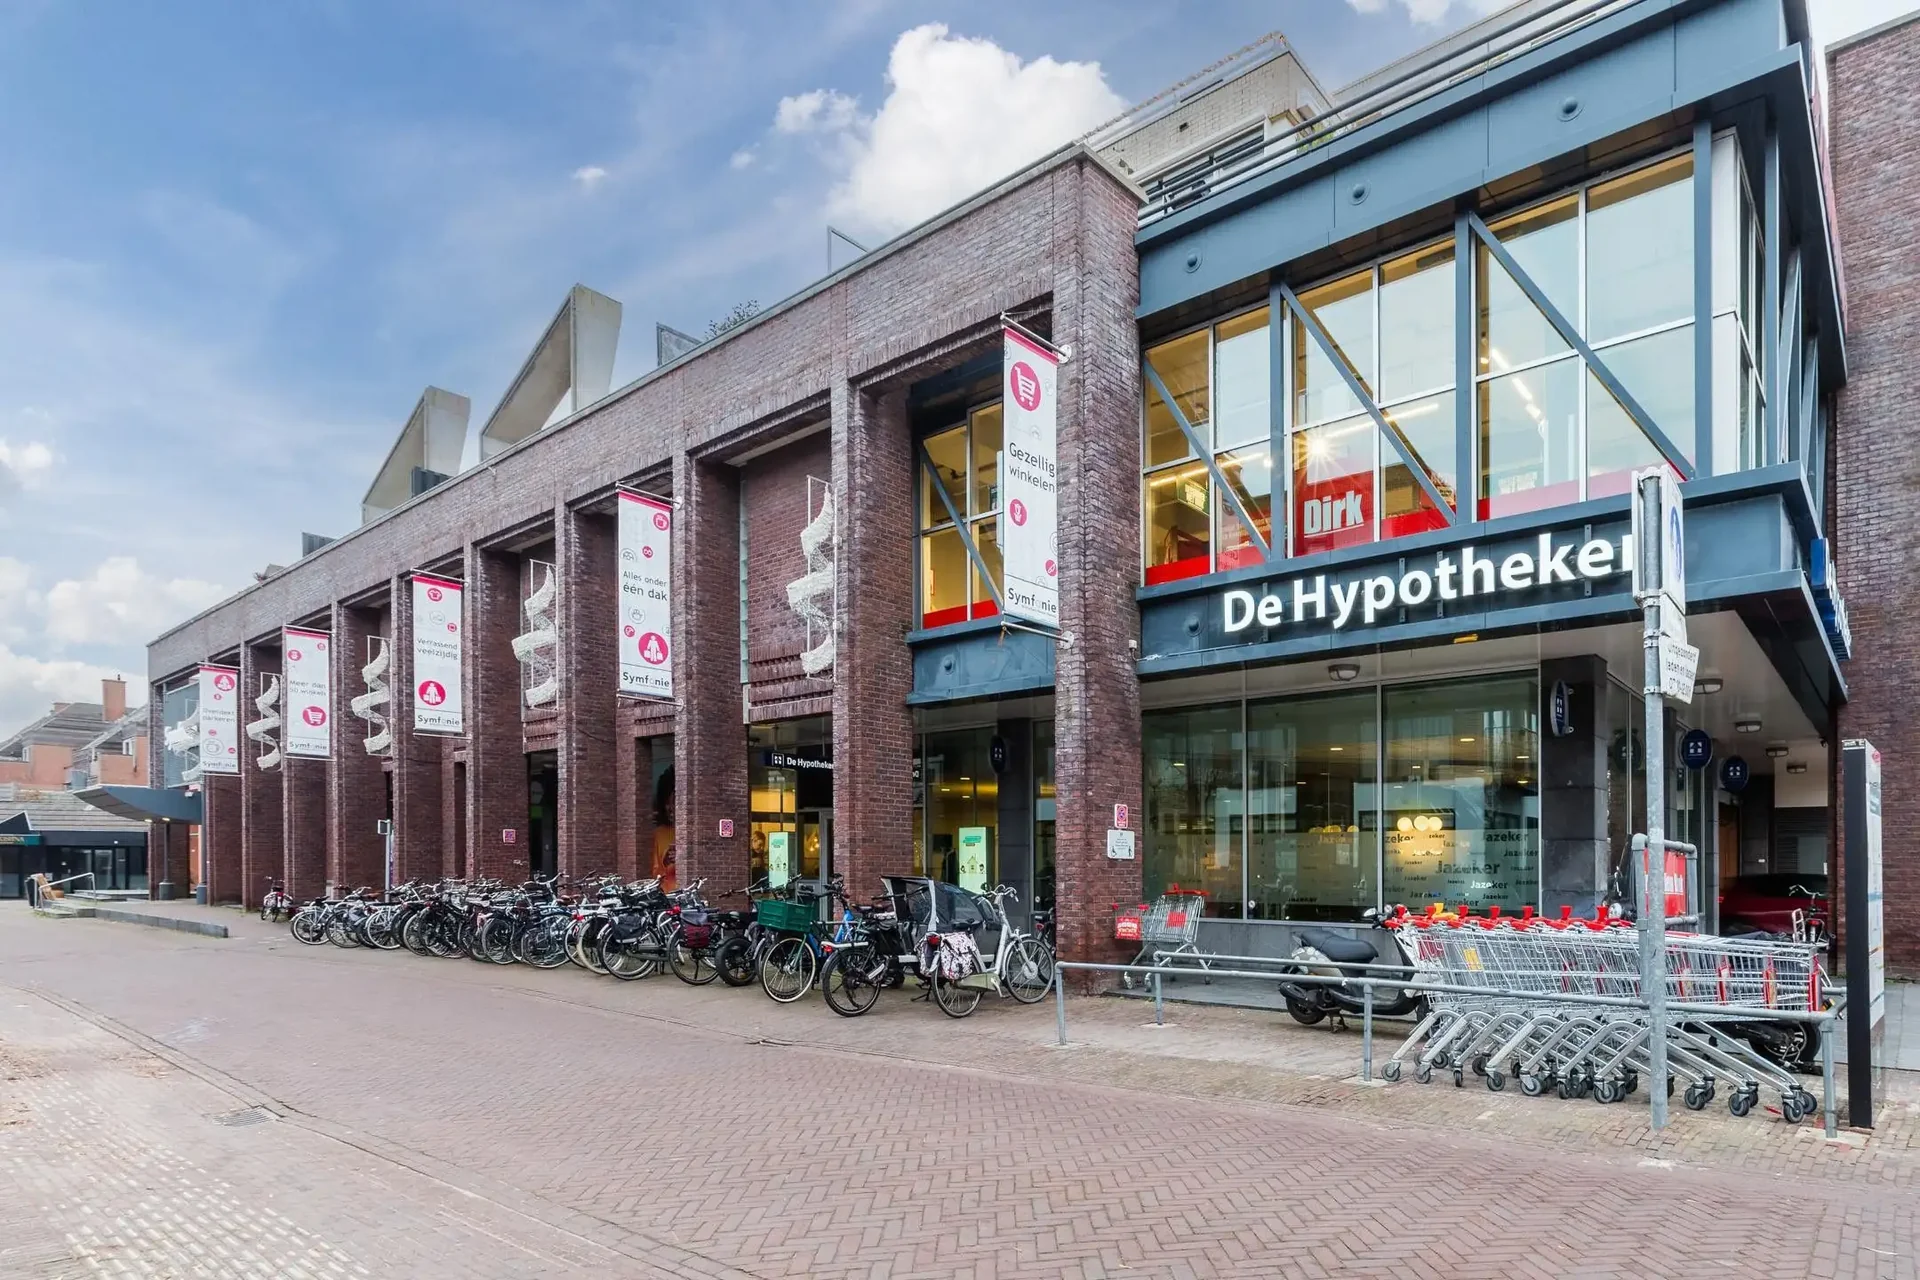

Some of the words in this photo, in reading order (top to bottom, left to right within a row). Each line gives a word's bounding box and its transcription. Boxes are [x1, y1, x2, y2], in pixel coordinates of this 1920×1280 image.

[1009, 442, 1055, 478] Gezellig
[1009, 465, 1055, 493] winkelen
[1304, 490, 1364, 534] Dirk
[623, 570, 642, 582] Alles
[644, 577, 667, 587] onder
[623, 582, 644, 596] één
[648, 588, 668, 602] dak
[1008, 587, 1057, 613] Symfonie
[1223, 588, 1282, 633] De
[416, 647, 458, 660] veelzijdig
[622, 671, 670, 687] Symfonie
[786, 757, 797, 766] De
[1471, 880, 1509, 889] Jazeker
